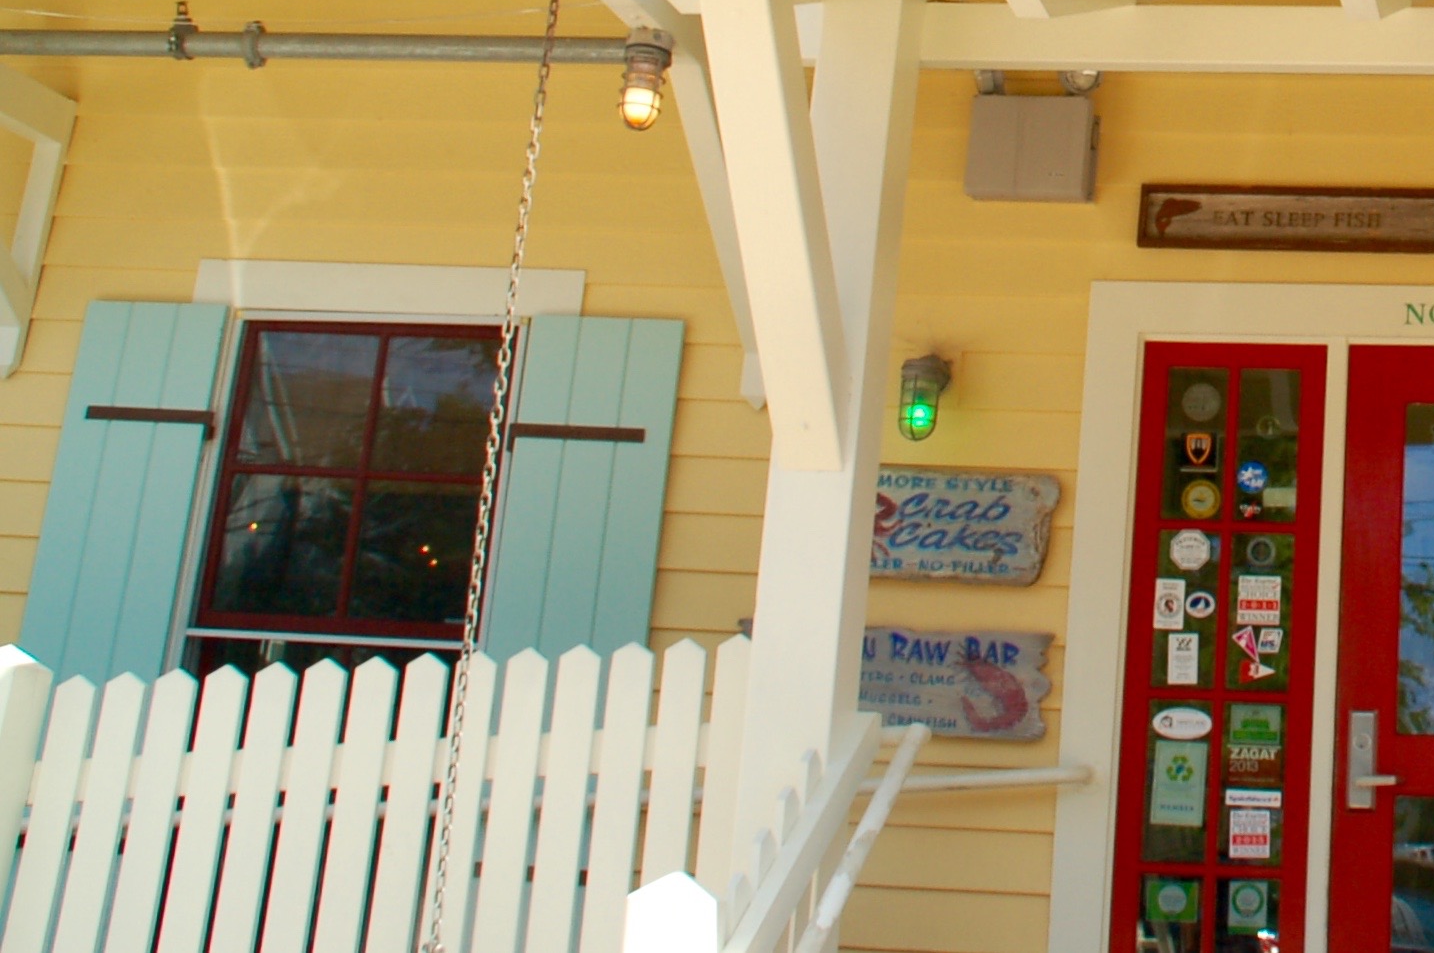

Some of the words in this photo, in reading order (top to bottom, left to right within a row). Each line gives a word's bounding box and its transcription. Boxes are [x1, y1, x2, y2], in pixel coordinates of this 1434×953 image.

[1213, 210, 1254, 227] EAT
[1262, 211, 1325, 228] SLEEP
[1333, 212, 1381, 229] FISH
[945, 476, 1014, 493] STYLE
[898, 492, 1012, 522] Crab
[889, 522, 1024, 555] Cakes
[891, 632, 951, 665] RAW
[964, 636, 1020, 666] BAR
[1229, 747, 1278, 760] ZAGAT
